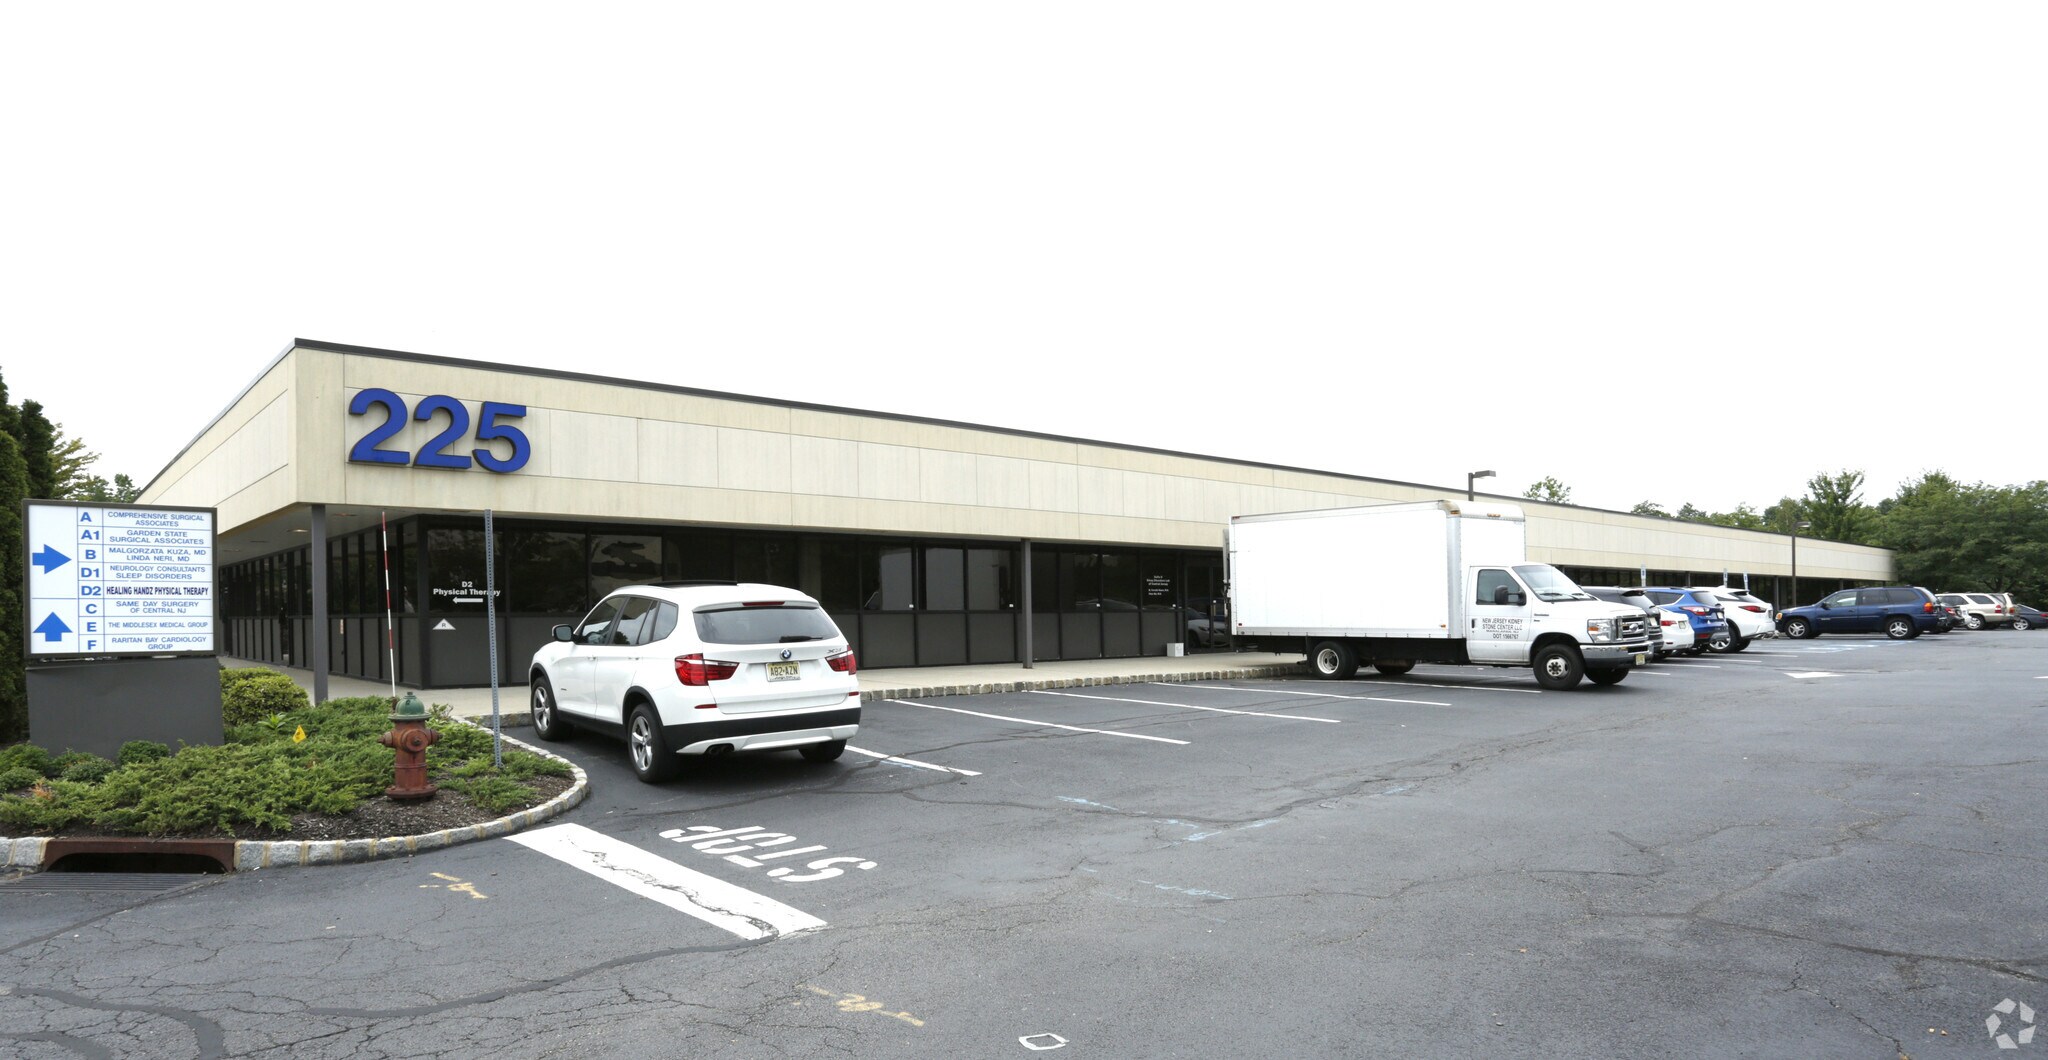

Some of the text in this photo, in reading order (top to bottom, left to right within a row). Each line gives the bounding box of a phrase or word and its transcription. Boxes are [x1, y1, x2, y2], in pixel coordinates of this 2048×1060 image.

[348, 387, 531, 473] 225
[80, 512, 92, 522] A
[108, 511, 168, 520] COMPREHENSIVE
[81, 530, 100, 540] A1
[85, 550, 96, 559] B
[81, 568, 99, 578] D1
[81, 586, 101, 596] D2
[107, 587, 132, 595] HEALING
[155, 587, 181, 595] PHYSICAL
[183, 587, 208, 596] THERAPY
[433, 588, 500, 596] Physical Therpy
[86, 604, 97, 614] C
[87, 622, 97, 632] E
[88, 640, 96, 650] F
[659, 826, 878, 882] STOP
